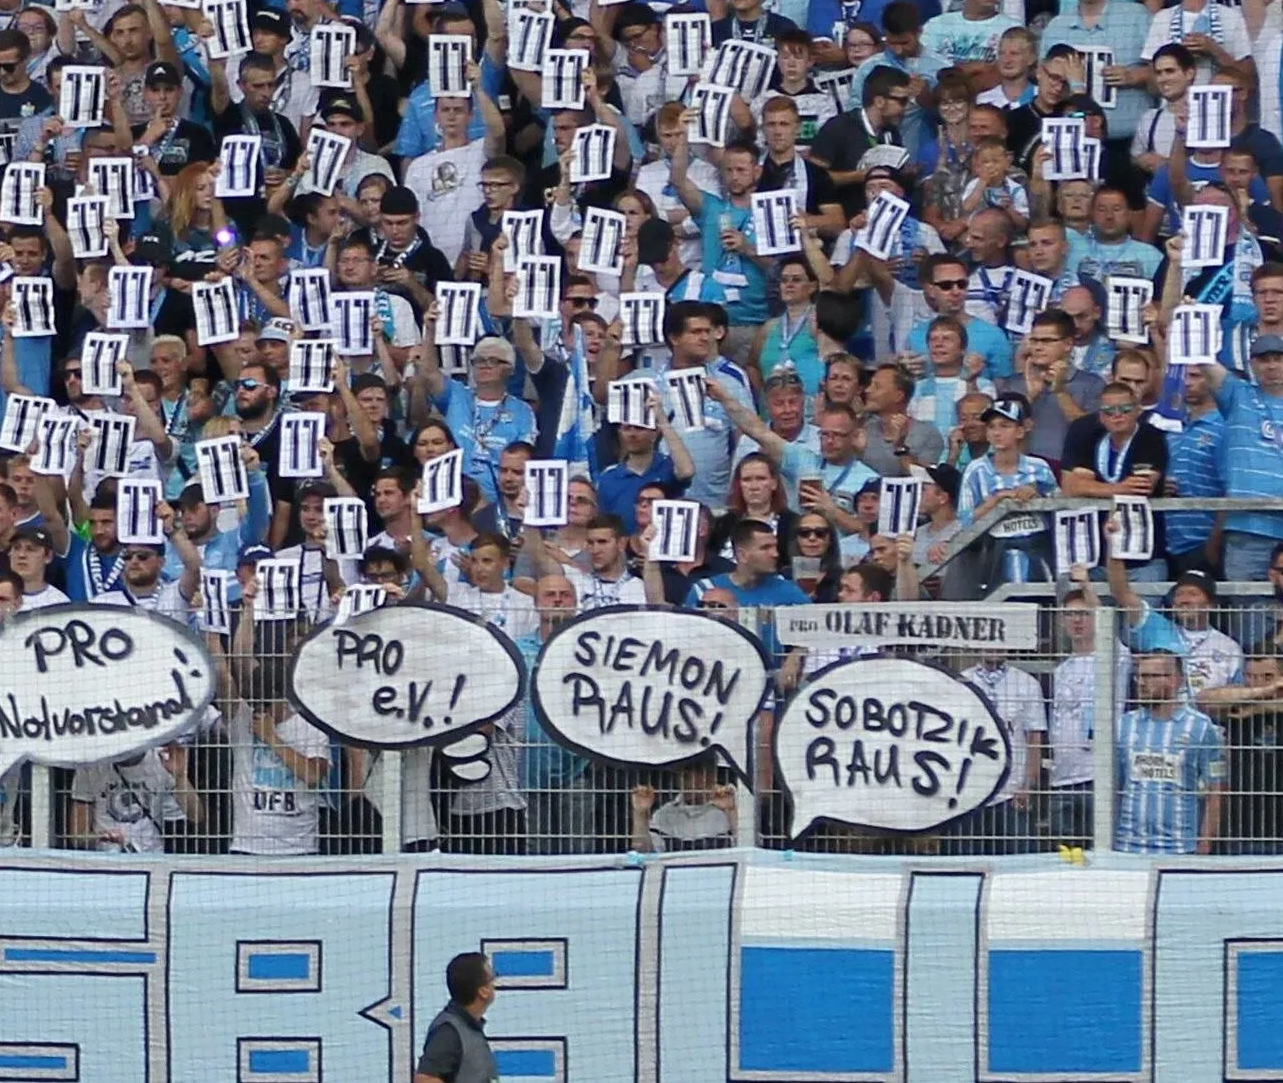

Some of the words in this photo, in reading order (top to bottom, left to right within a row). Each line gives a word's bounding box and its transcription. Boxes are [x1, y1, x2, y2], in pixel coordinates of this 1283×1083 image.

[434, 42, 476, 91] 11
[672, 20, 709, 69] 11
[66, 73, 101, 122] 11
[1193, 91, 1227, 141] 11
[1189, 211, 1222, 260] 11
[113, 272, 147, 321] 11
[197, 285, 234, 336] 11
[515, 262, 555, 312] 11
[335, 299, 376, 348] 11
[1174, 310, 1210, 357] 11
[201, 442, 243, 496] 11
[285, 420, 320, 470] 11
[529, 467, 563, 519] 11
[26, 618, 134, 673] PRO
[825, 610, 891, 636] OLAF
[897, 613, 1005, 642] KADNER
[334, 629, 405, 675] PRO
[574, 630, 742, 705] SIEMON
[563, 672, 723, 747] RAUS!
[804, 687, 1001, 761] SOBOTZIK
[806, 737, 973, 809] RAUS!
